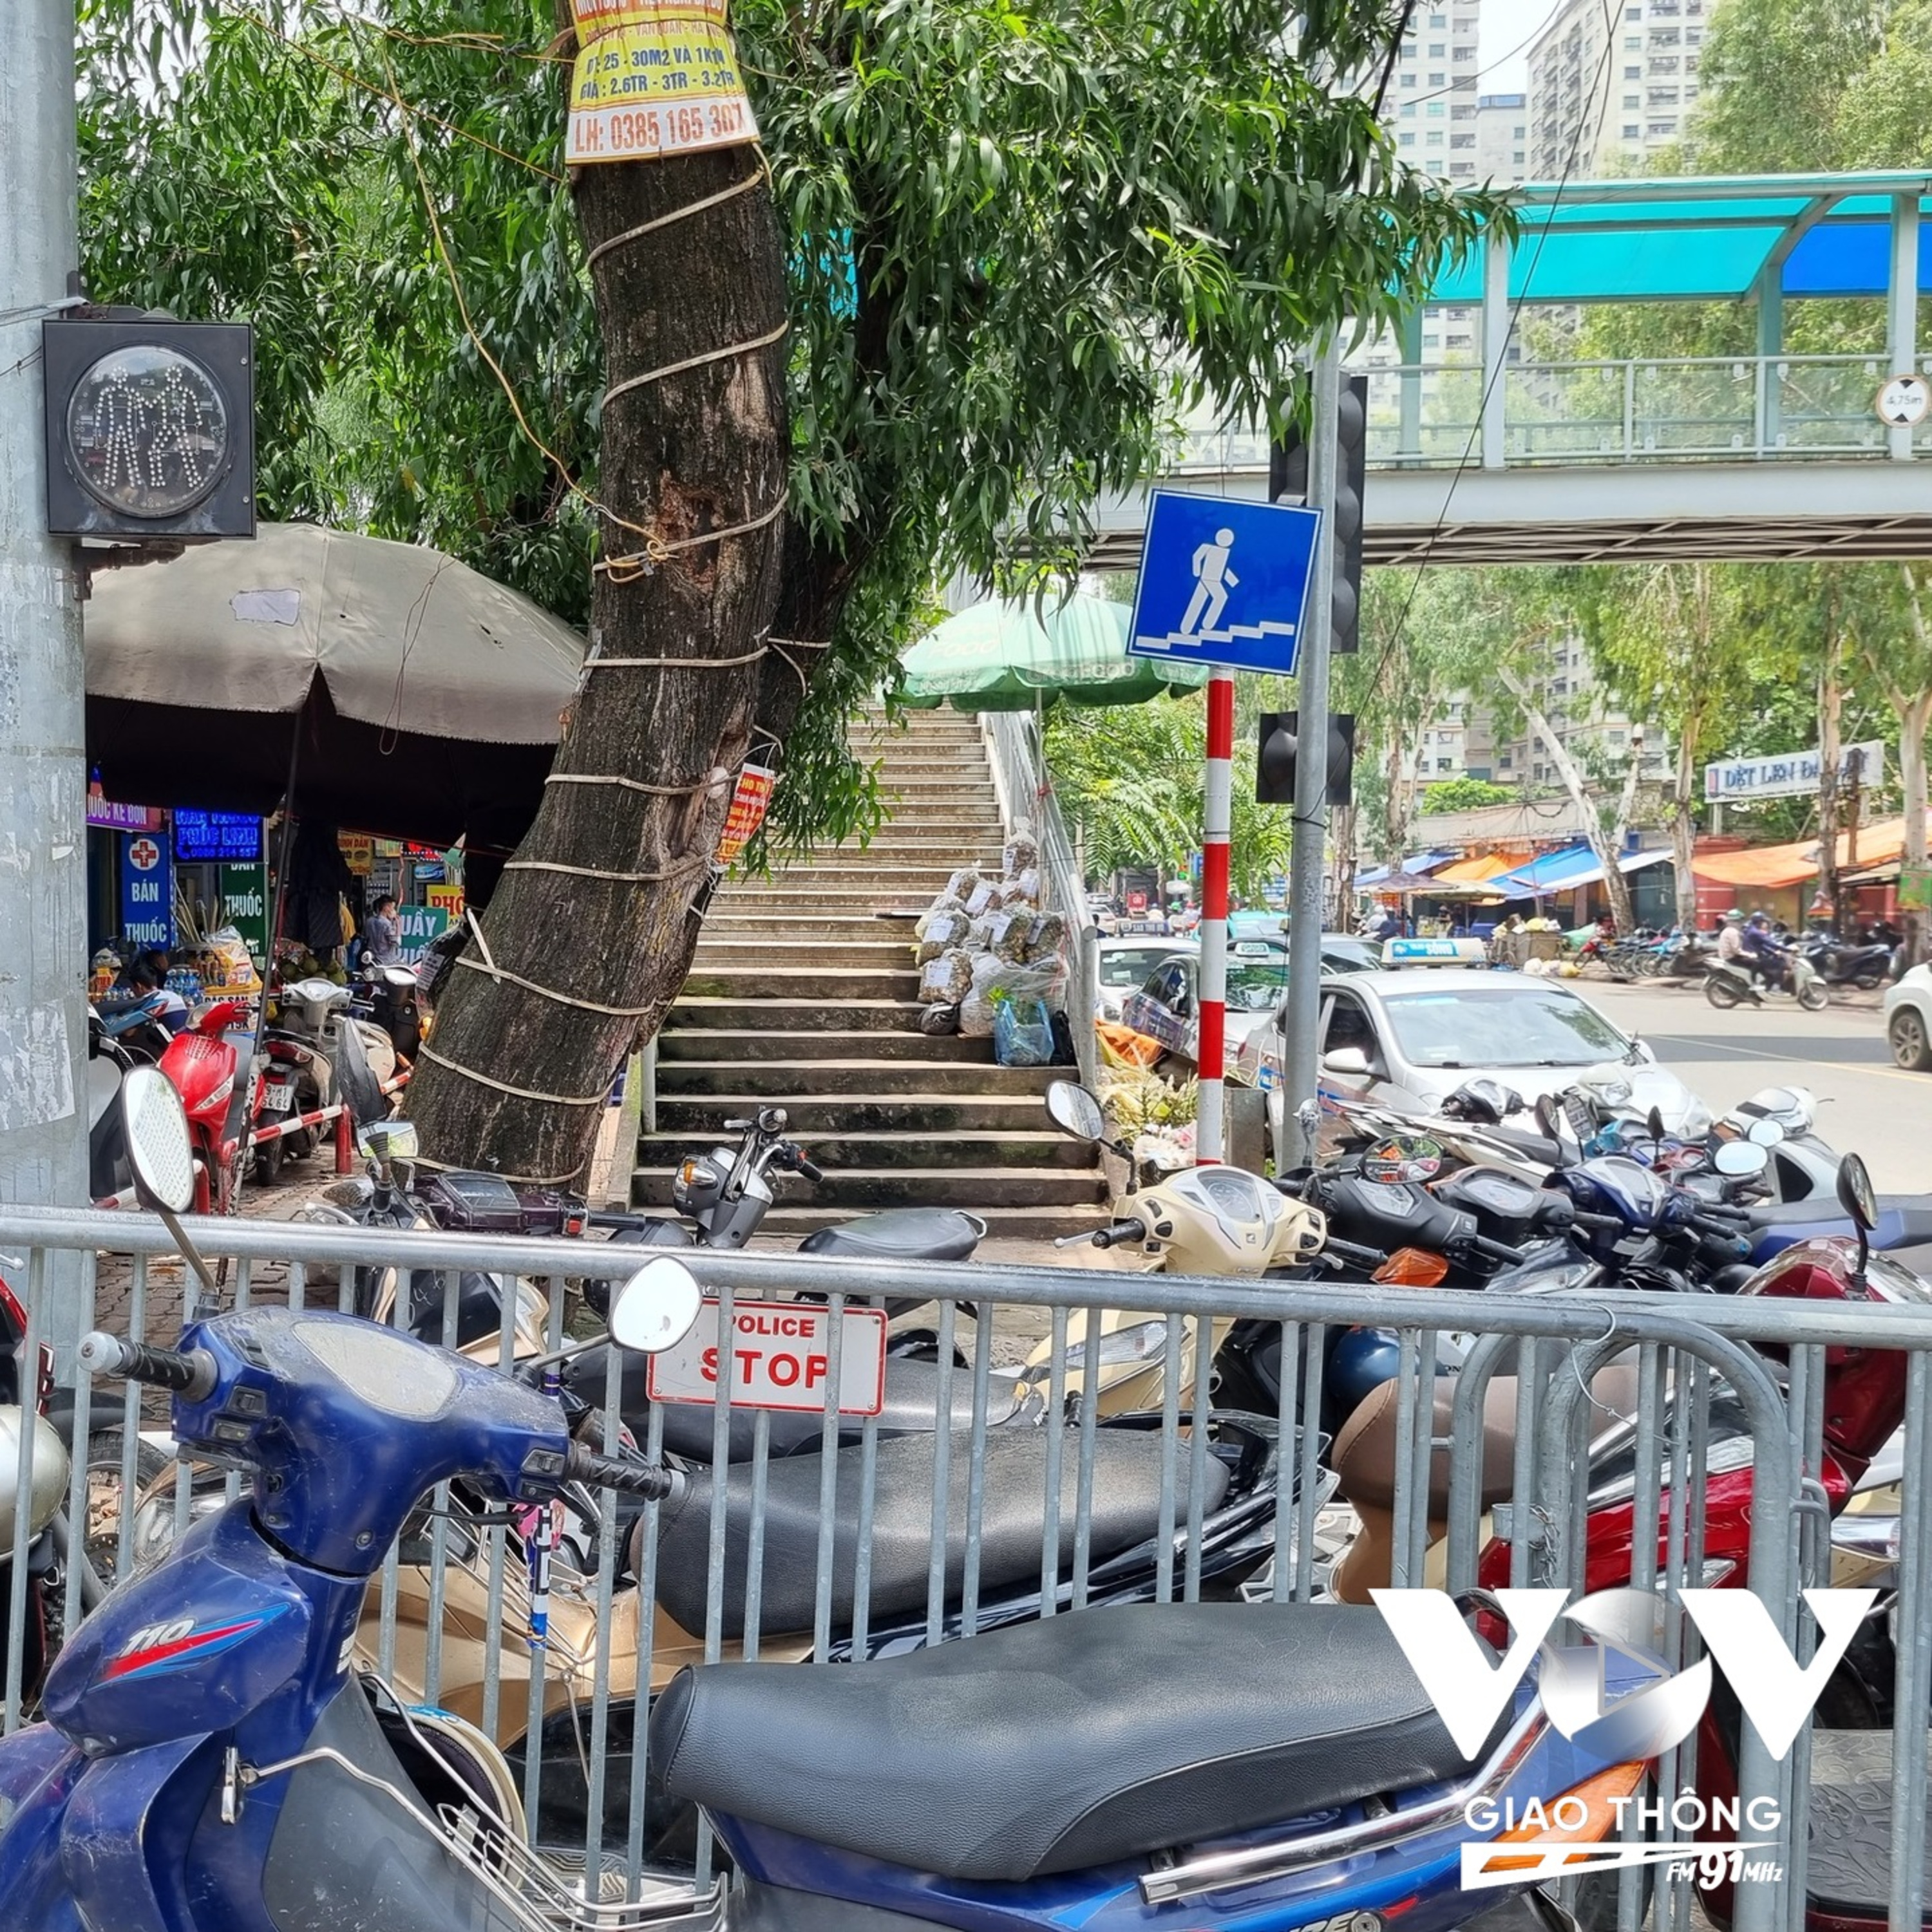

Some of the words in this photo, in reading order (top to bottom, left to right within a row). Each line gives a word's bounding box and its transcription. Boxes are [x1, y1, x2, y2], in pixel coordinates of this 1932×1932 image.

[604, 53, 619, 71] 25
[632, 50, 670, 66] 30M2
[673, 44, 692, 64] VÀ
[610, 75, 648, 95] 2.6TR
[662, 72, 688, 90] 3TR
[701, 70, 735, 87] 3.2TR
[575, 118, 603, 152] LH:
[611, 111, 660, 150] 0385
[666, 107, 704, 144] 165
[131, 878, 159, 902] BÁN
[225, 887, 262, 917] THUỐC
[125, 916, 167, 943] THUỐC
[400, 909, 437, 937] UẦY
[732, 1315, 815, 1338] OLICE
[701, 1347, 828, 1388] STOP
[120, 1618, 194, 1658] 110
